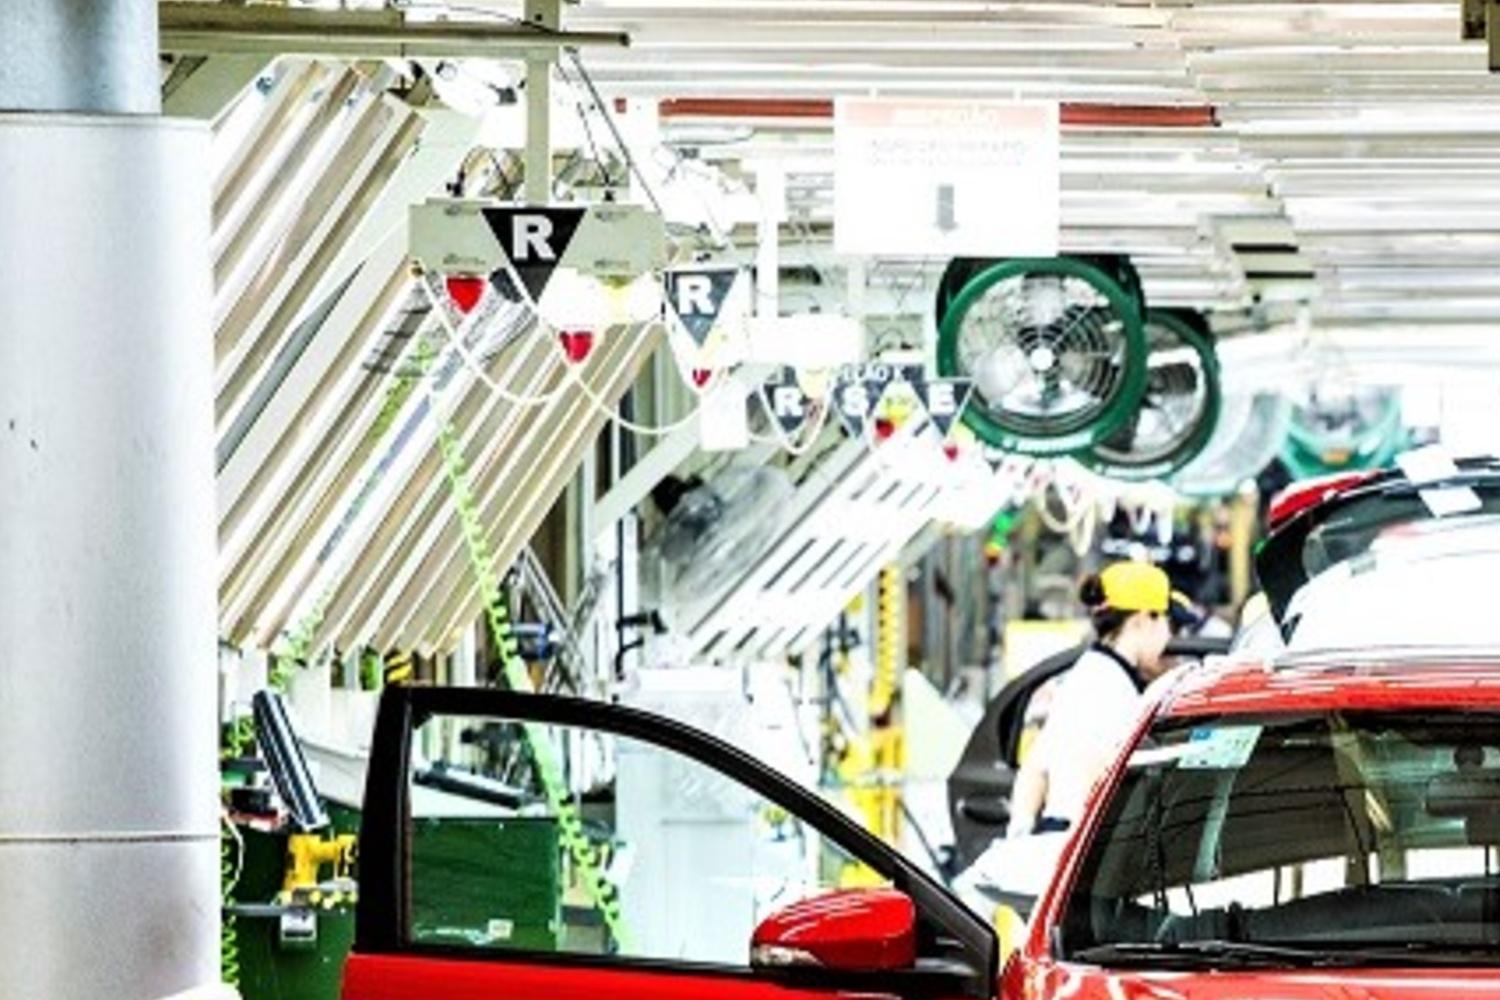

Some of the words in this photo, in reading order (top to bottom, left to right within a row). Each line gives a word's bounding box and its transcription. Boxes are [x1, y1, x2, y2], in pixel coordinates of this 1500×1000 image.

[512, 214, 556, 260] R
[676, 274, 715, 315] R
[774, 385, 804, 417] R
[927, 384, 954, 414] E
